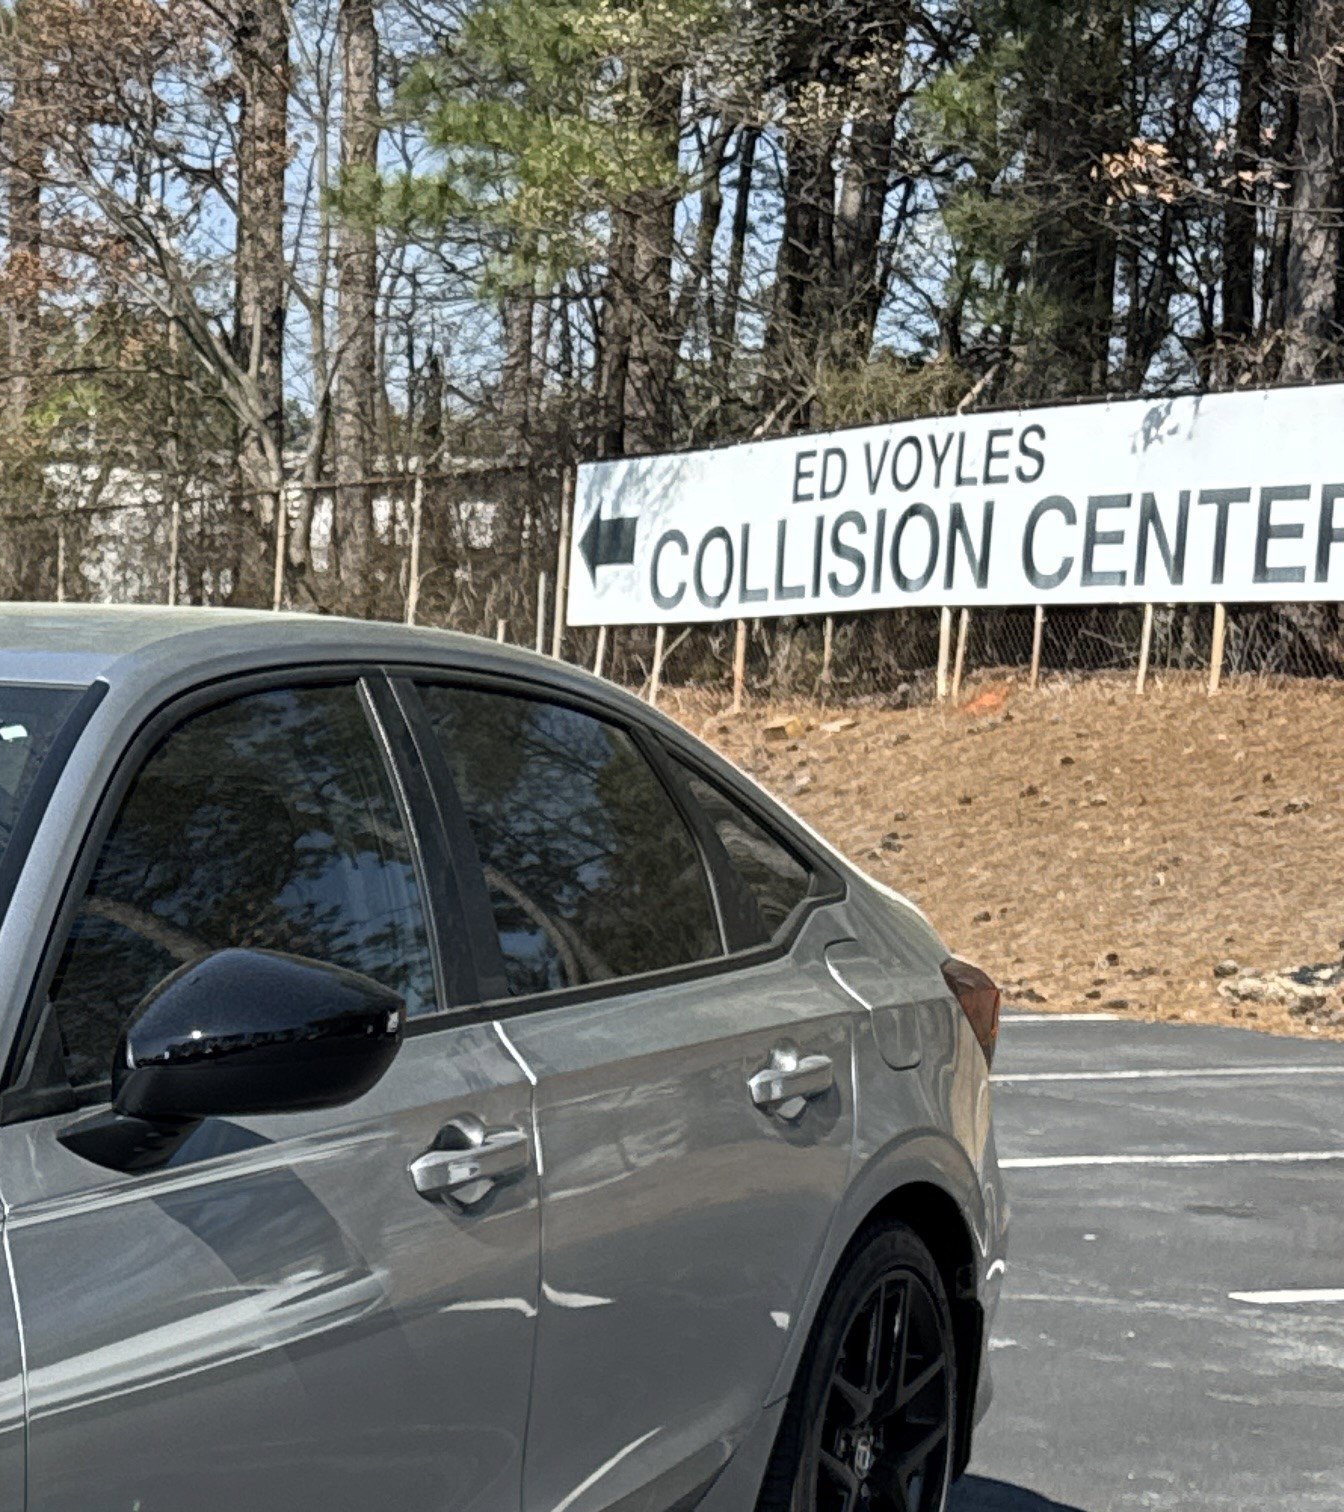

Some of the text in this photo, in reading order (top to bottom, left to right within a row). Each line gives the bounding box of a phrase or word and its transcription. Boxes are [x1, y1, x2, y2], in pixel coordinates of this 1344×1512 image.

[792, 423, 1047, 504] ED VOYLES
[649, 499, 996, 610] COLLISION
